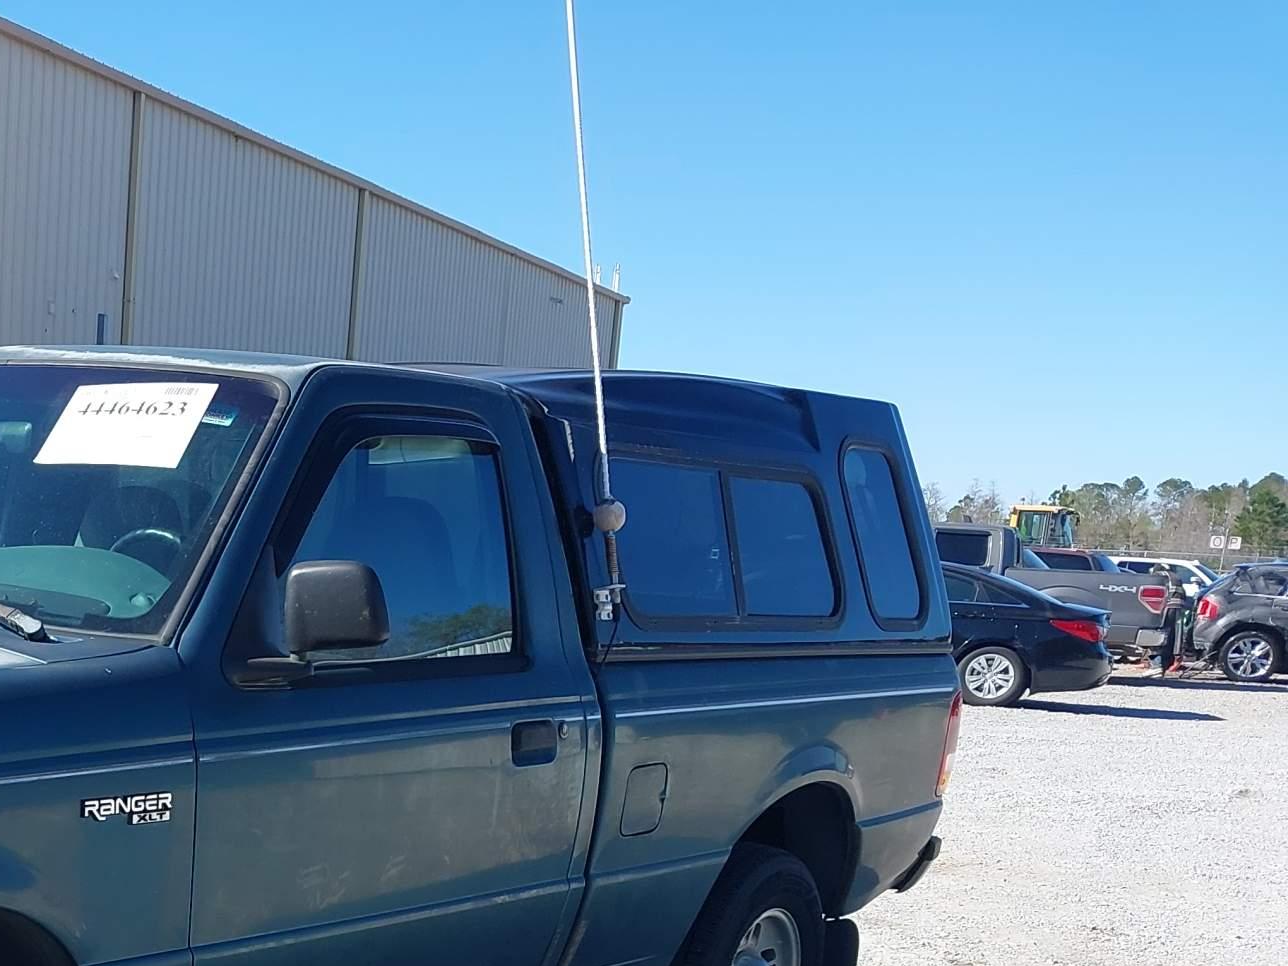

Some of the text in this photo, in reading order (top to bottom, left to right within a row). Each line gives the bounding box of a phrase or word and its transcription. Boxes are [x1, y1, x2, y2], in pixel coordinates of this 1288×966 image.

[78, 401, 188, 416] 44464623
[84, 792, 172, 821] RANGER
[136, 812, 167, 823] XLT
